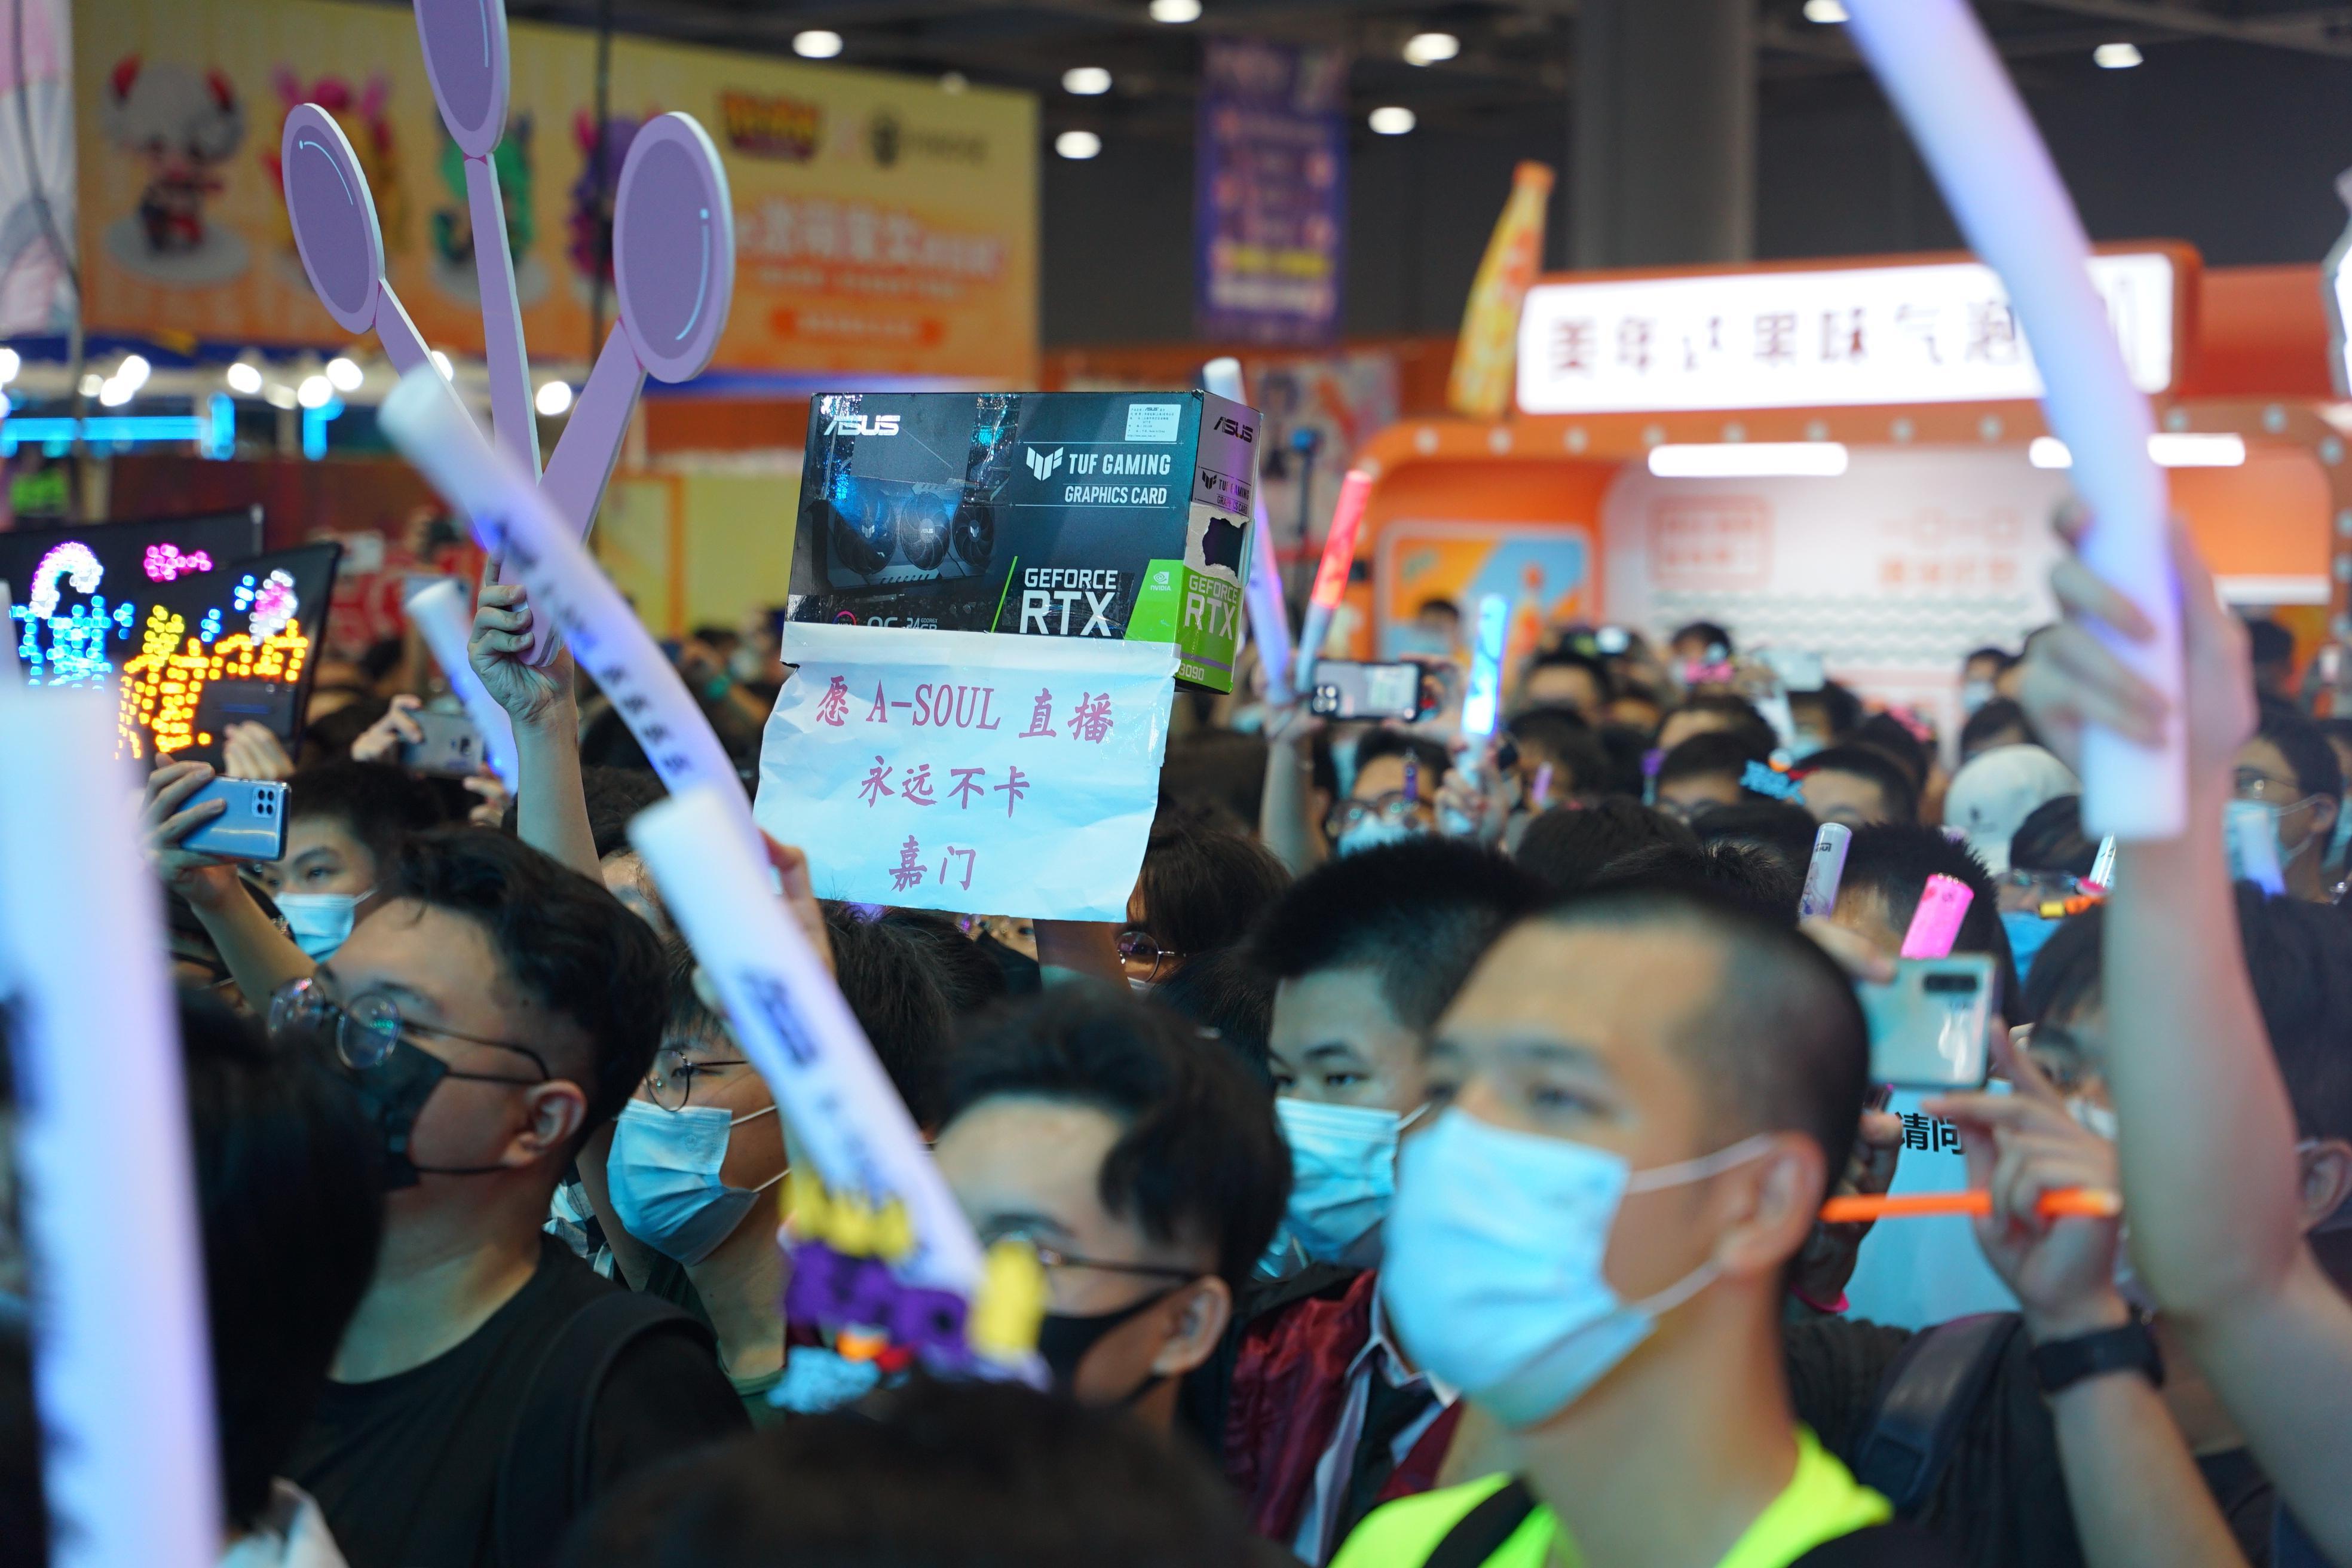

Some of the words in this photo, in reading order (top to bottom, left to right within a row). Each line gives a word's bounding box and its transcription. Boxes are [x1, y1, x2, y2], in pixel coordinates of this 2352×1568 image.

[823, 415, 901, 436] ASUS
[1214, 416, 1253, 443] ASUS
[1069, 454, 1098, 474] TUF
[1102, 454, 1171, 475] GAMING
[1064, 486, 1128, 503] GRAPHICS
[1131, 487, 1167, 504] CARD
[1024, 568, 1118, 590] GEFORCE
[1189, 574, 1238, 604] GEFORCE
[1019, 589, 1116, 636] RTX
[1185, 592, 1236, 641] RTX
[1178, 663, 1205, 681] 3090
[816, 675, 849, 727] 愿
[865, 679, 1001, 730] A-SOUL
[1019, 688, 1114, 744] 直播
[858, 756, 1031, 818] 永远不卡
[889, 835, 976, 892] 嘉门
